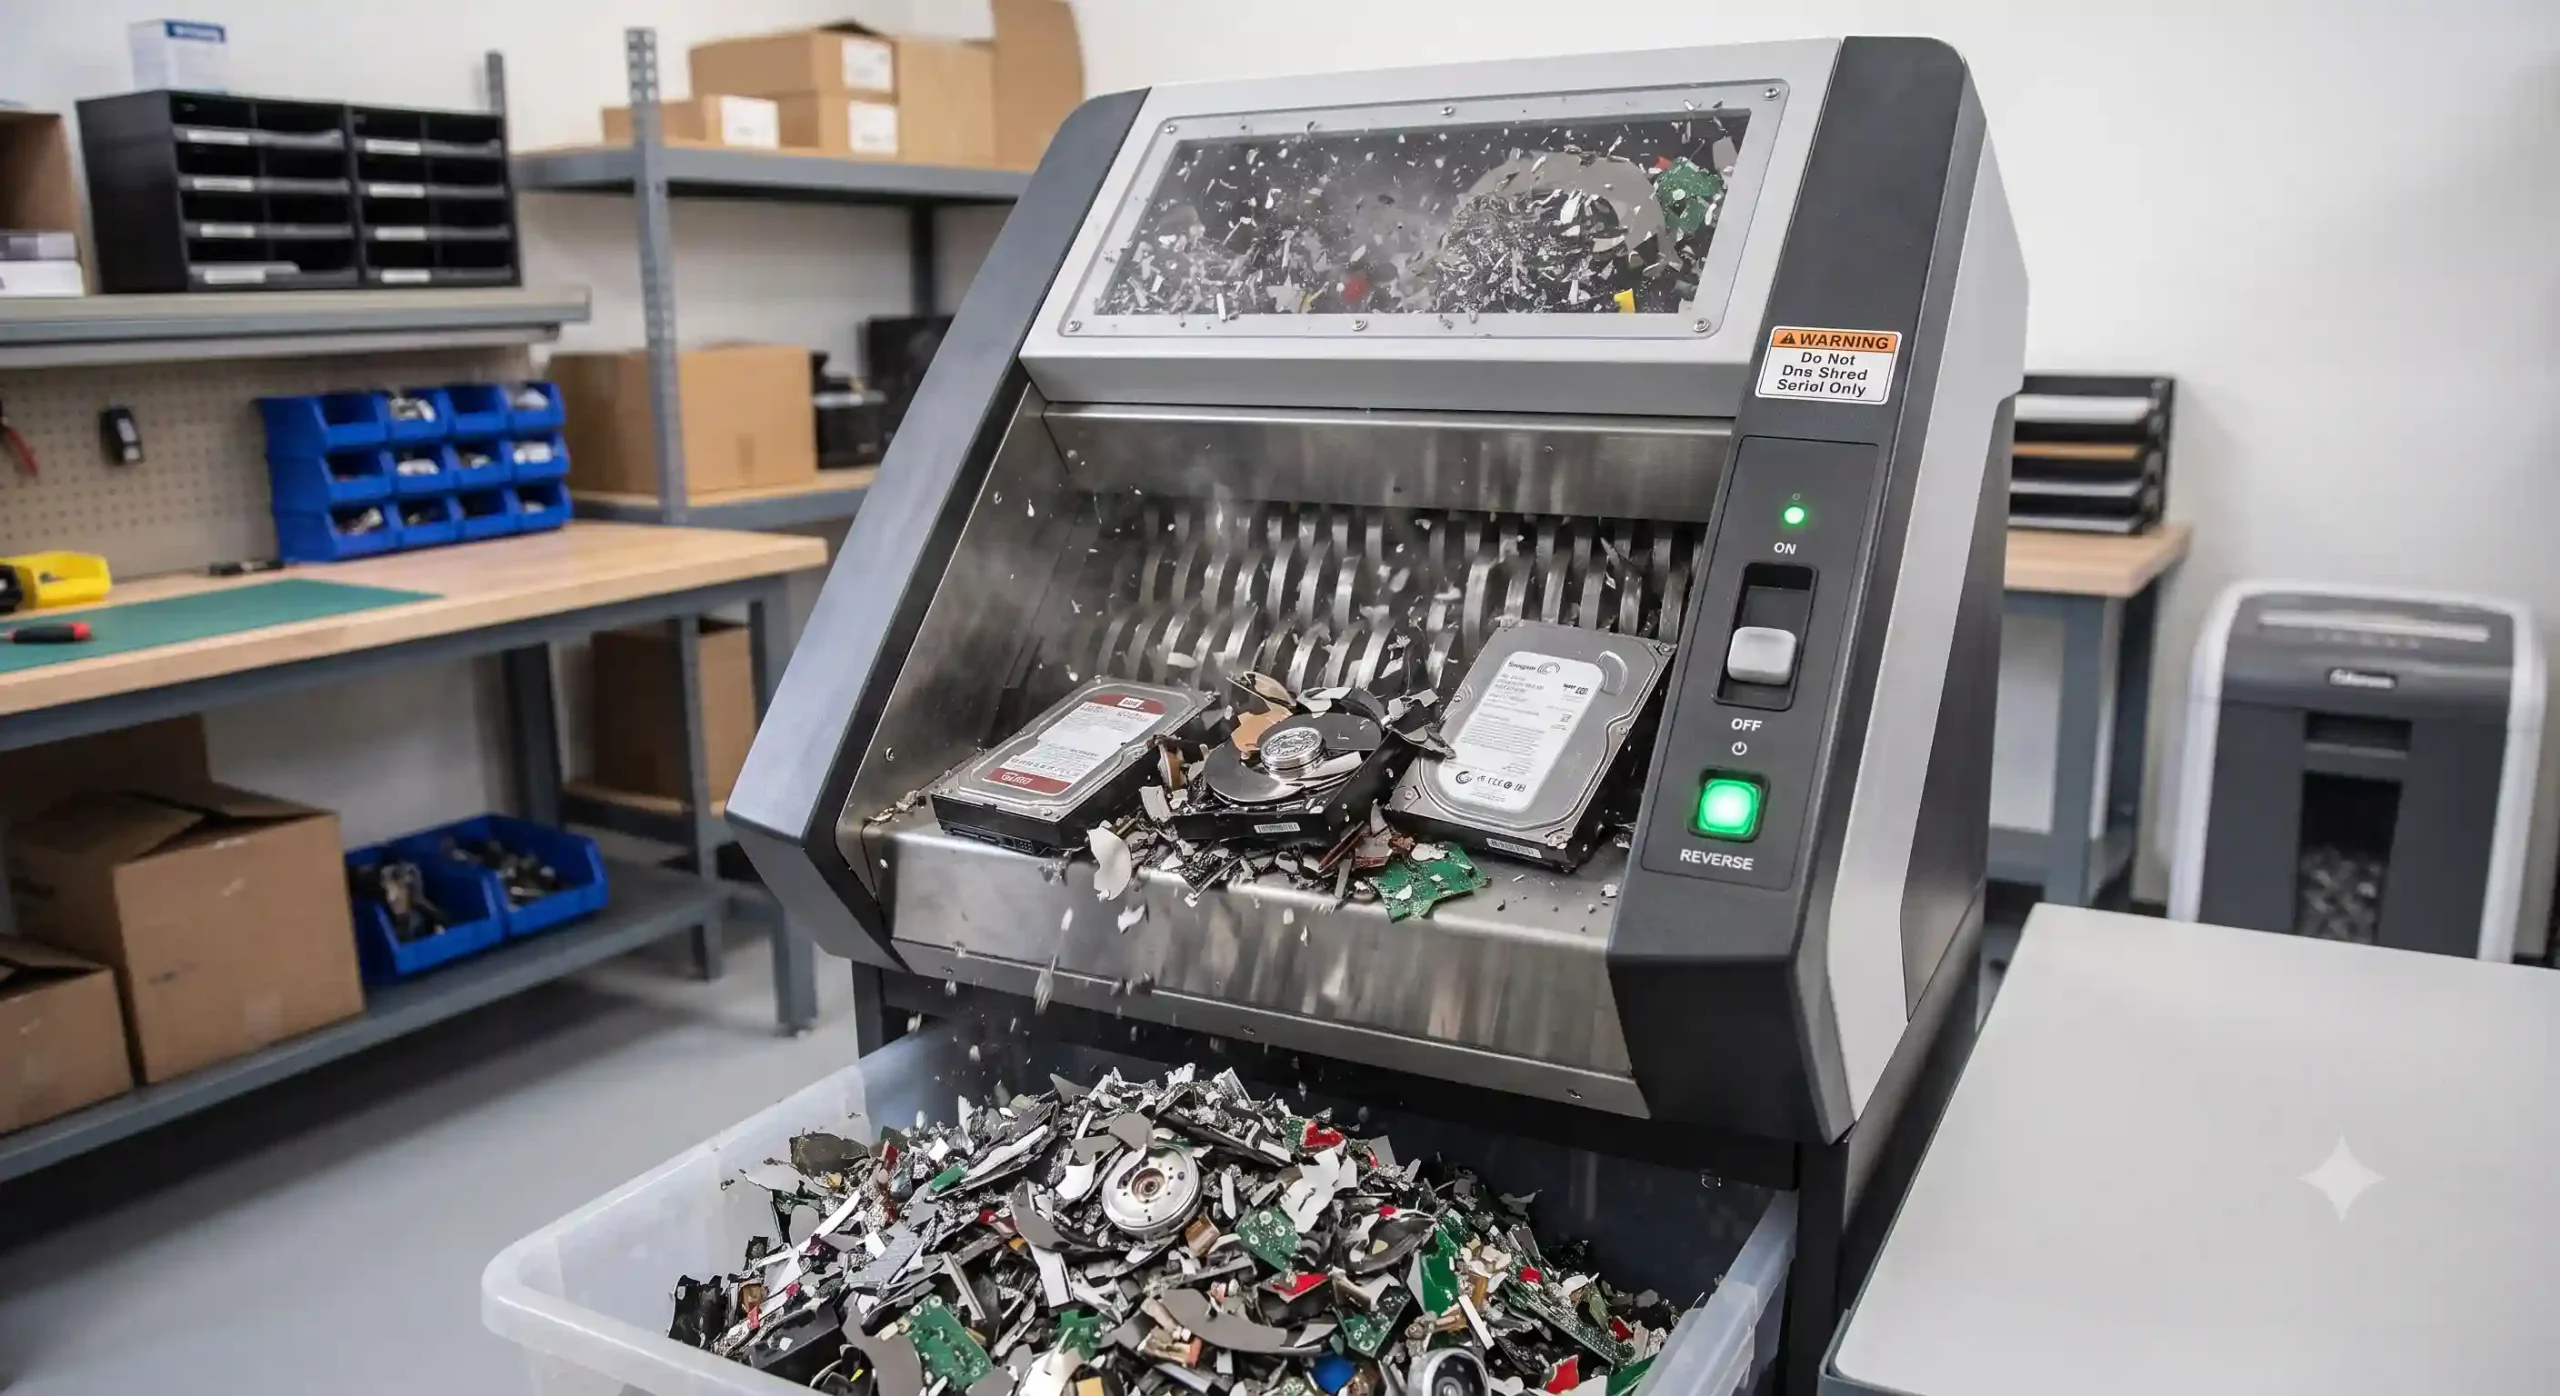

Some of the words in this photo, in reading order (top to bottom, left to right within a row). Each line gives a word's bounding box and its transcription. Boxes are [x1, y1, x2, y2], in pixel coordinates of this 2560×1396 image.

[1800, 333, 1889, 349] WARNING
[1801, 352, 1822, 364] Do
[1828, 353, 1857, 366] Not
[1782, 364, 1813, 378] Dns
[1818, 366, 1868, 381] Shred
[1829, 381, 1867, 398] Only
[1773, 541, 1797, 555] ON
[1731, 718, 1763, 733] OFF
[1680, 849, 1754, 871] REVERSE
